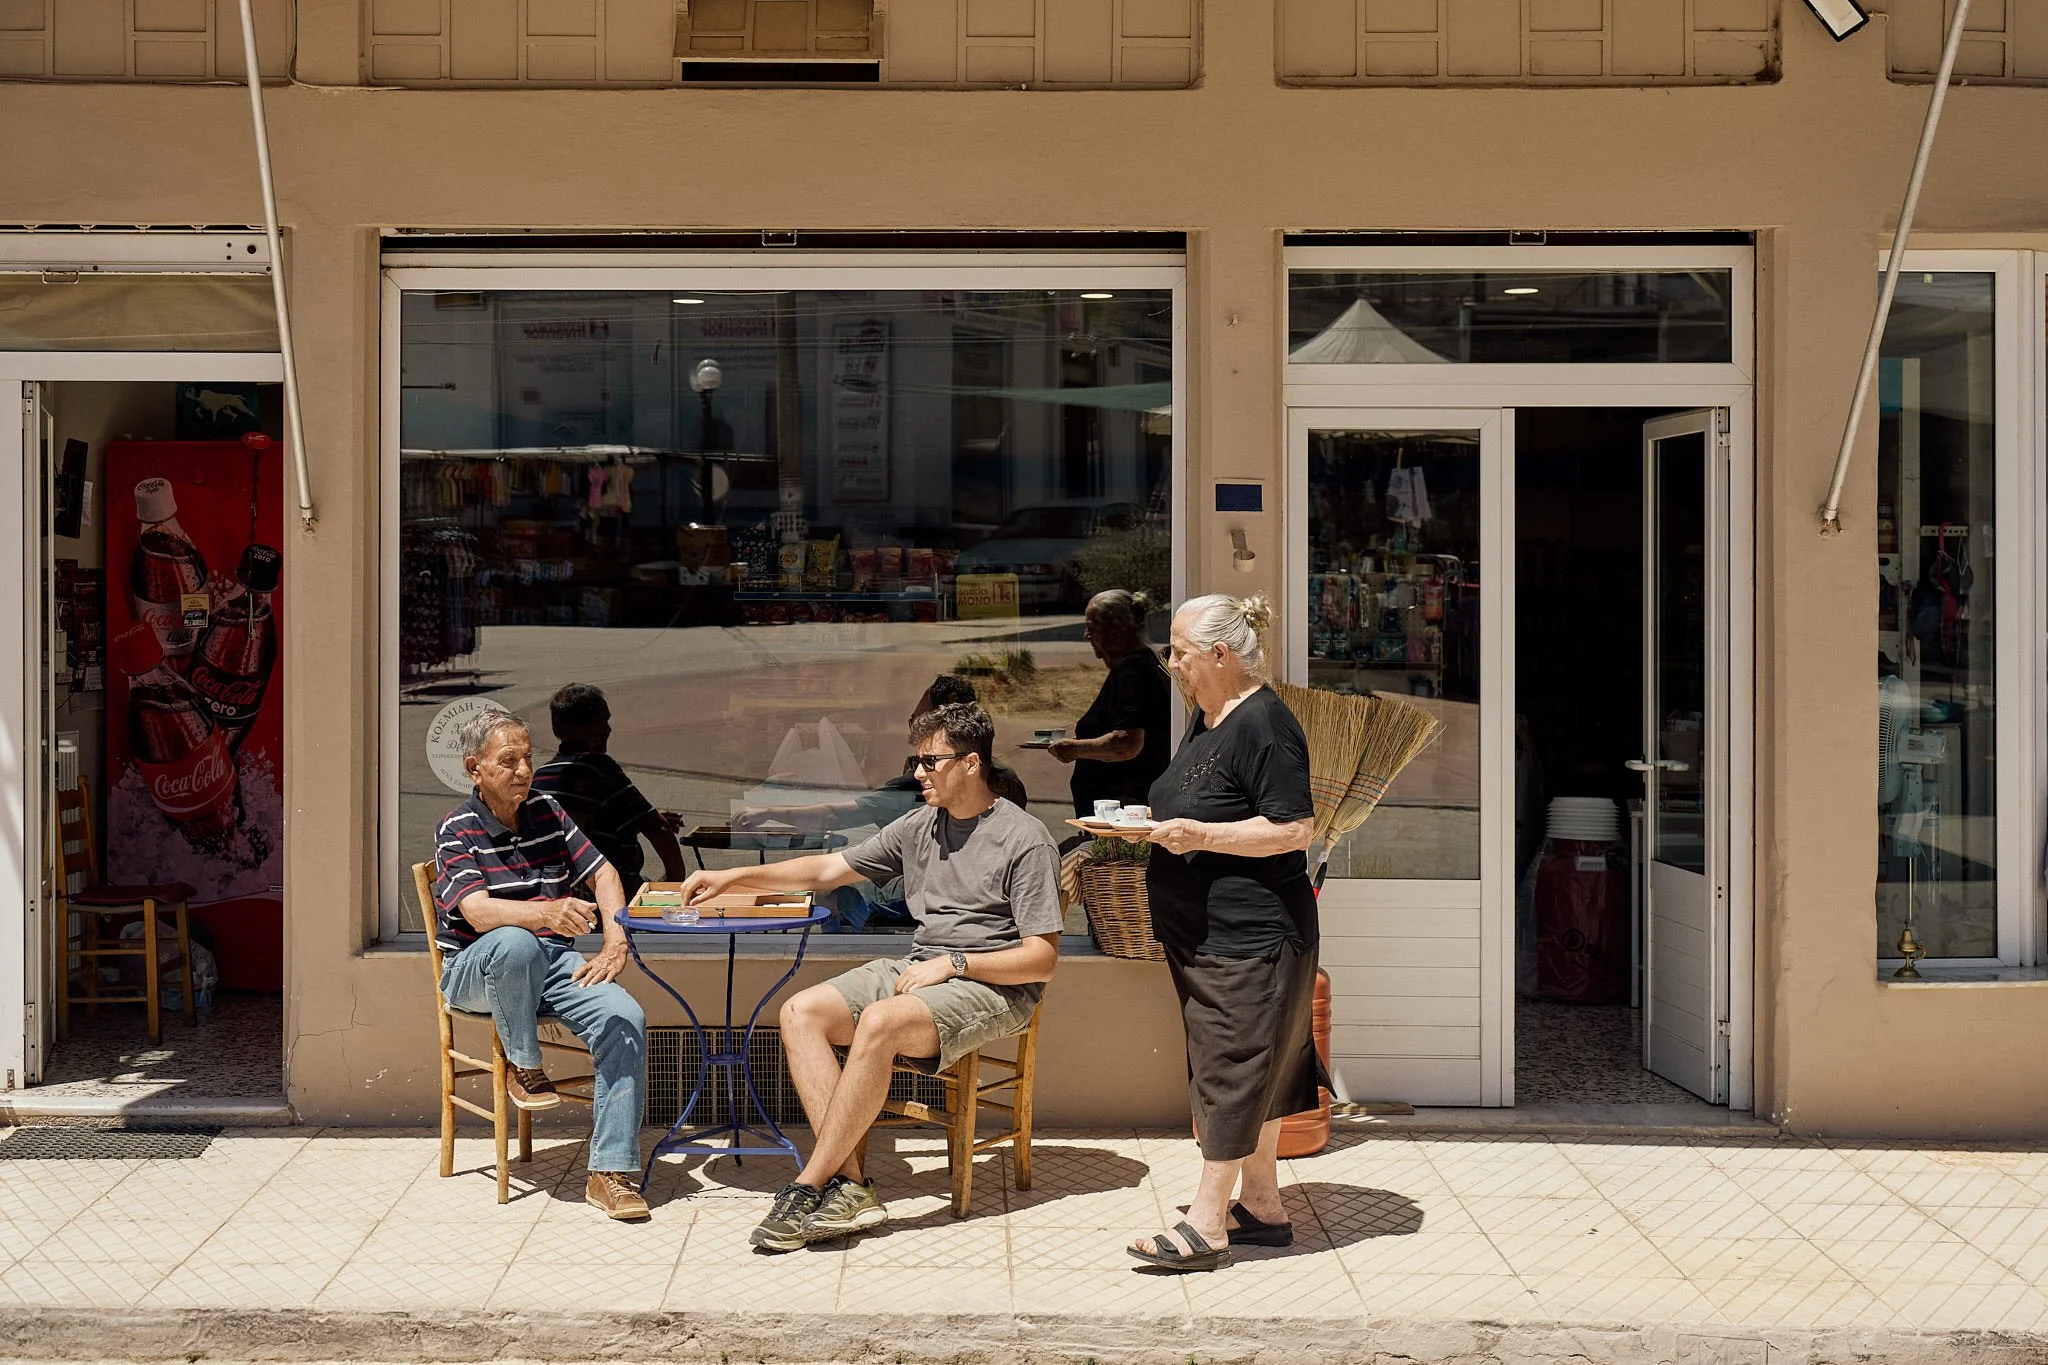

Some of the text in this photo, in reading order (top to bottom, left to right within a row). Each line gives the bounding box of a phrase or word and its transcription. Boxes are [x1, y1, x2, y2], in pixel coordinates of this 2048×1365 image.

[191, 665, 263, 705] Coca-Cola
[431, 702, 473, 743] ΚΟΣΜΙΔΗ
[153, 744, 226, 800] Coca-Cola
